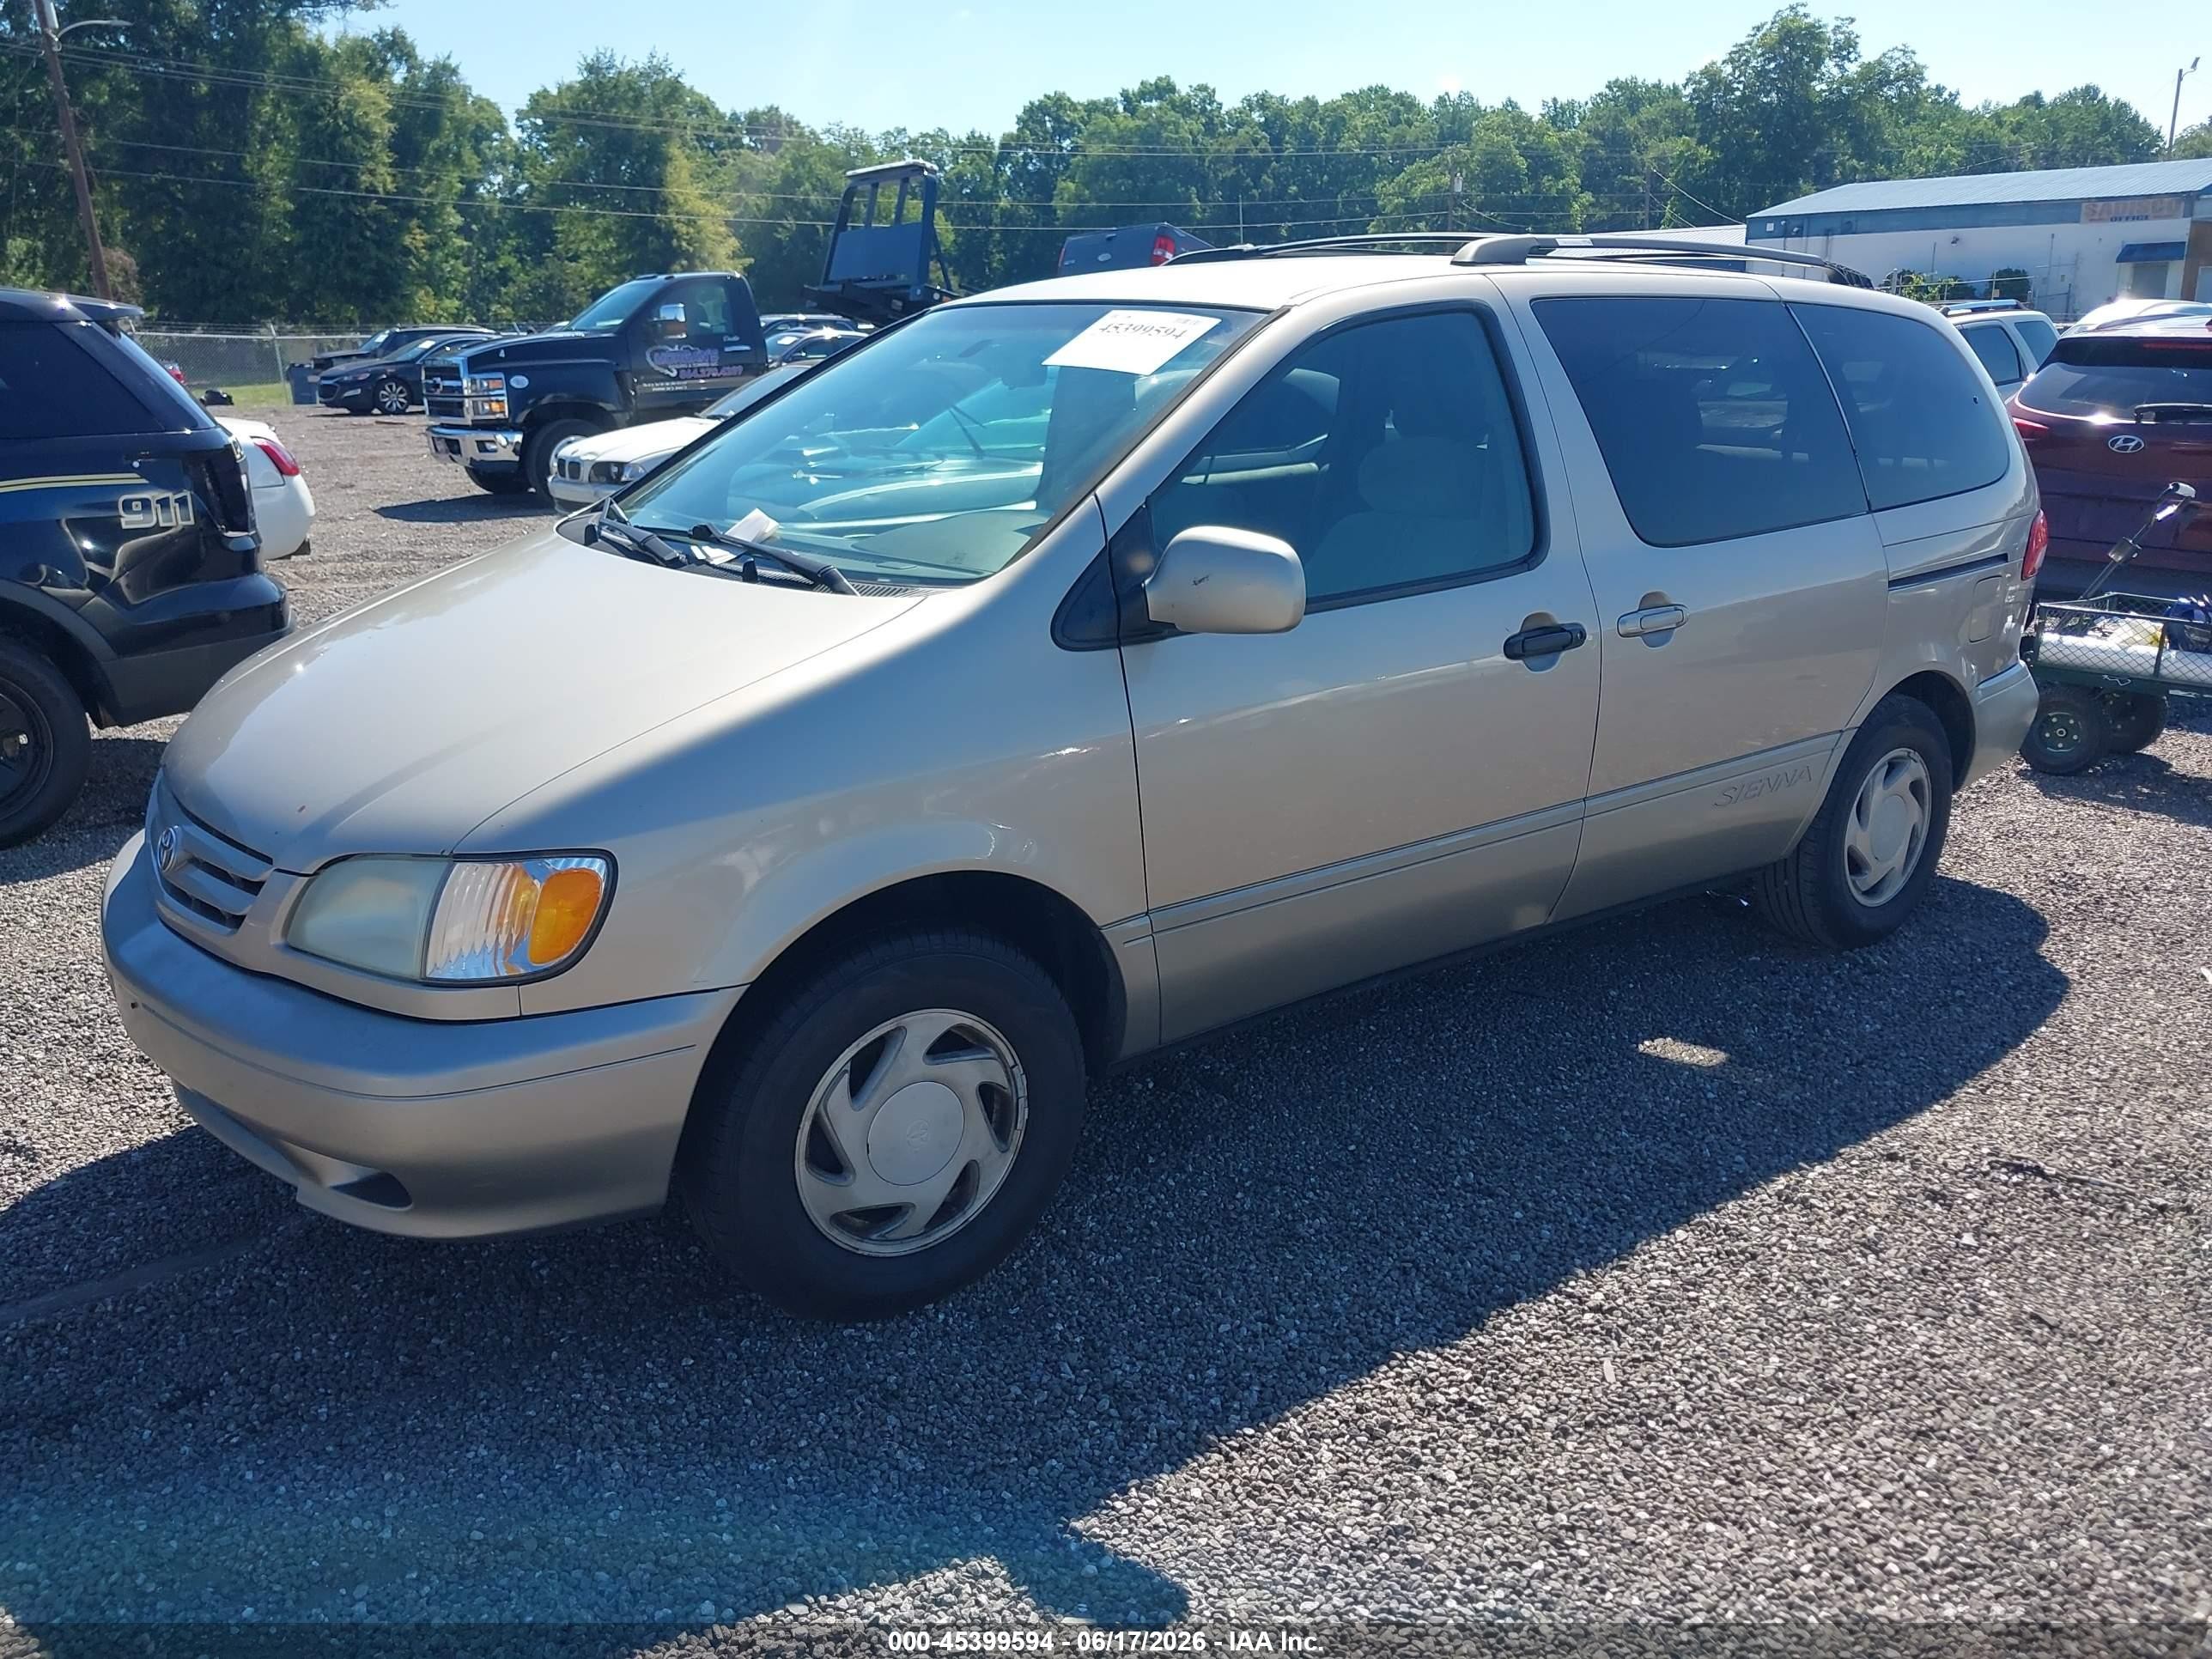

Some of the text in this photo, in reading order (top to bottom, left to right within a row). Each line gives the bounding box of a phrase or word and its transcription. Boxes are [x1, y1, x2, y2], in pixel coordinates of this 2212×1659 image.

[1100, 323, 1188, 339] 45399594
[118, 489, 195, 529] 911
[1714, 765, 1812, 807] SIENNA
